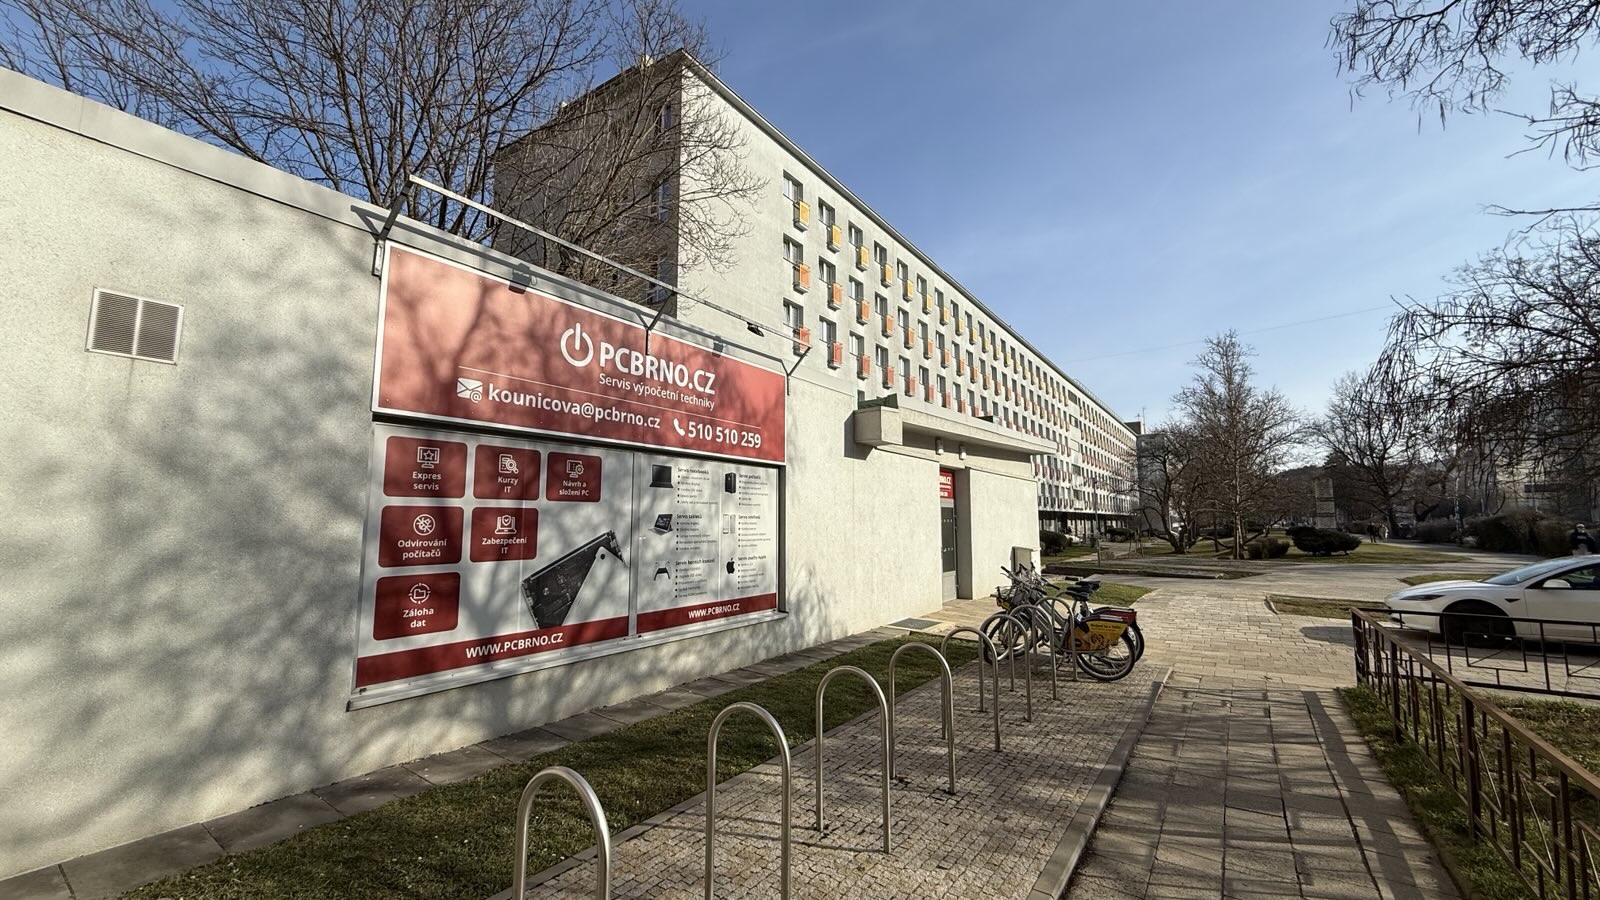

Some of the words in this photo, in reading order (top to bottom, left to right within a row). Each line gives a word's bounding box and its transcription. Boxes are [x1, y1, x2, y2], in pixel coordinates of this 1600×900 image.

[600, 342, 715, 395] PCBRNO.CZ
[599, 373, 631, 390] Servis
[633, 380, 679, 401] výpočetní
[680, 391, 715, 410] techniky
[488, 384, 660, 429] kounicova@pcbrno.cz
[688, 422, 713, 440] 510
[716, 427, 738, 444] 510
[741, 431, 761, 448] 259
[412, 471, 441, 481] Expres
[498, 476, 518, 486] Kurzy
[413, 481, 439, 491] servis
[563, 479, 581, 488] Návrh
[559, 488, 580, 496] složení
[398, 538, 447, 548] Odvirování
[482, 536, 527, 546] Zabezpečení
[402, 548, 441, 560] počítačů
[403, 606, 434, 618] Záloha
[688, 603, 740, 619] WWW.PCBRNO.CZ
[410, 619, 426, 628] dat
[466, 632, 563, 658] WWW.PCBRNO.CZ
